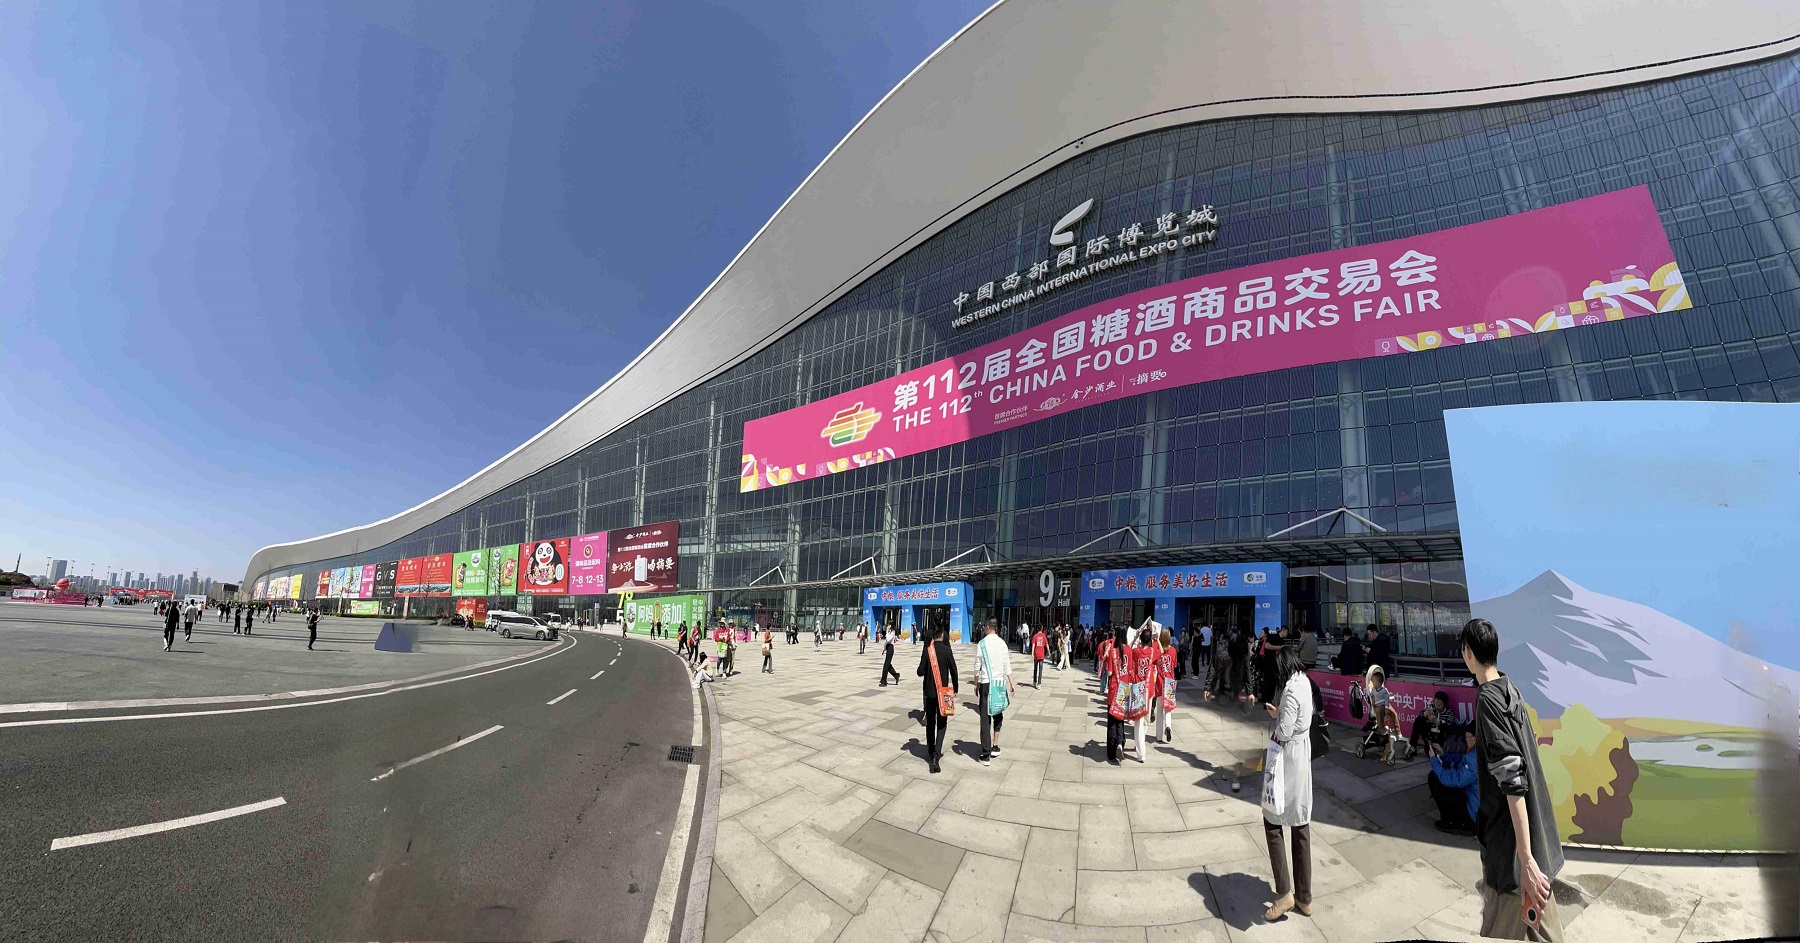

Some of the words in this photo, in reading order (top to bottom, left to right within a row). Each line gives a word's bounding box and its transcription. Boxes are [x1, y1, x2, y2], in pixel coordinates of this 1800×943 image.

[951, 302, 1000, 329] WESTERN
[1001, 290, 1035, 310] CHINA
[1036, 251, 1138, 295] INTERNATIONAL
[1139, 238, 1178, 258] EXPO
[1181, 229, 1216, 247] CITY
[952, 204, 1218, 312] 中国西部国际博览城
[892, 248, 1439, 412] 第112届全国糖酒商品交易会
[892, 406, 932, 432] THE
[989, 365, 1070, 404] CHINA
[1075, 338, 1159, 377] FOOD
[1169, 331, 1192, 354] &
[1205, 304, 1340, 345] DRINKS
[1354, 288, 1441, 322] FAIR
[1040, 569, 1054, 607] 9
[1058, 580, 1071, 596] 厅
[1057, 598, 1071, 607] Hall
